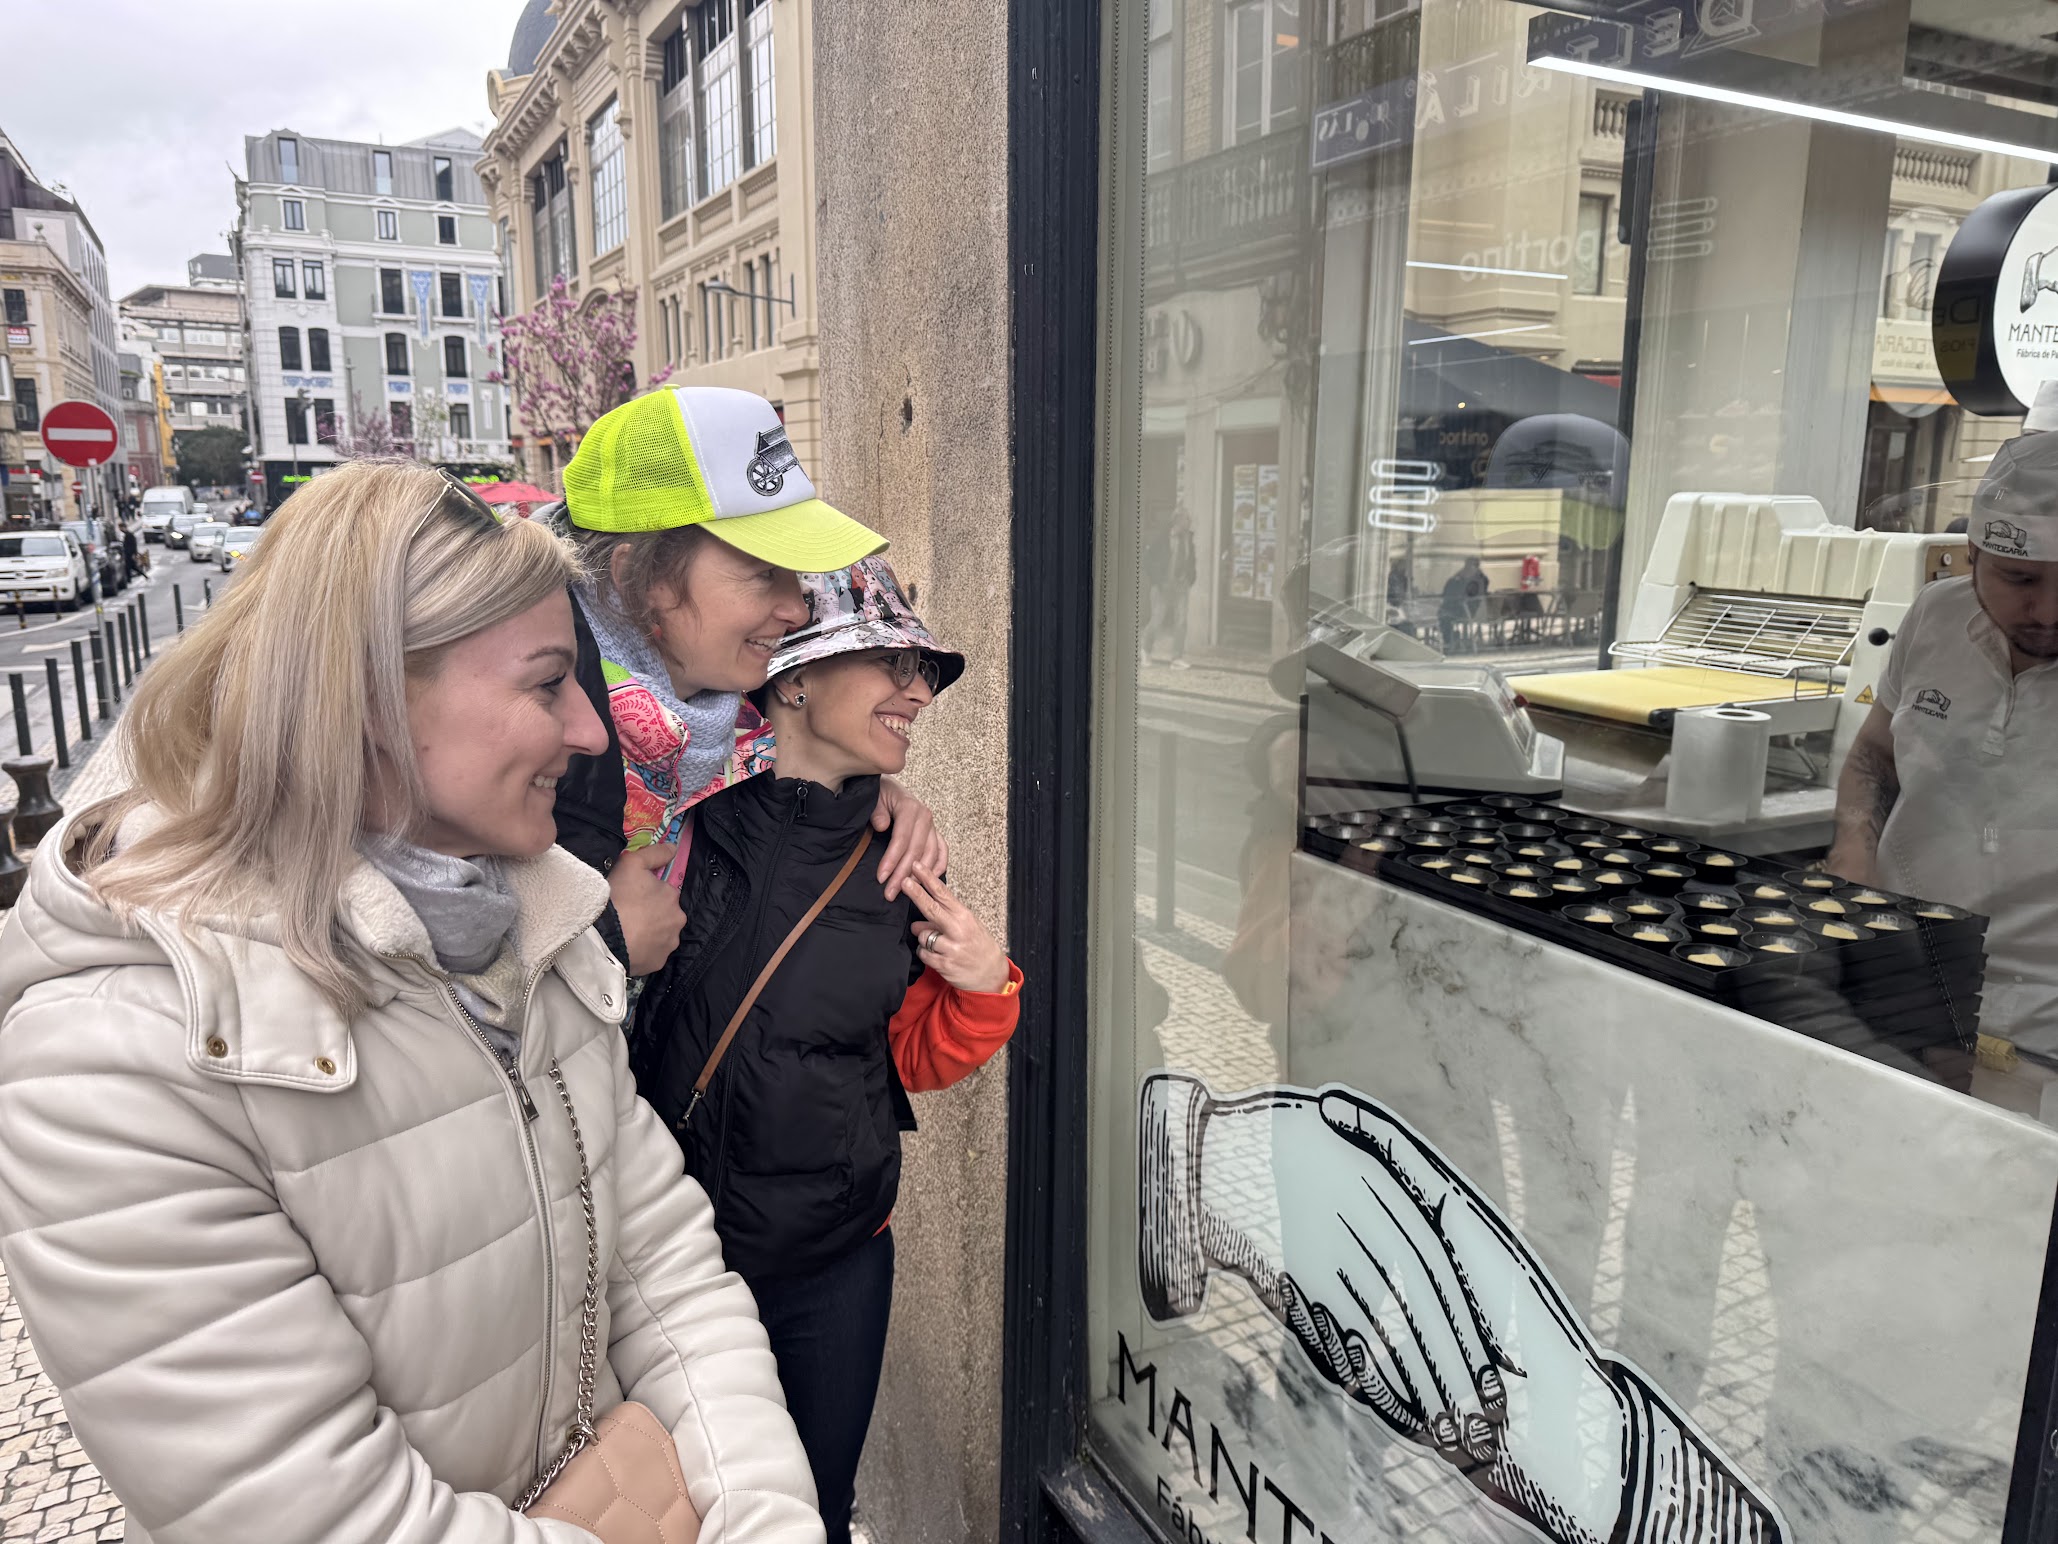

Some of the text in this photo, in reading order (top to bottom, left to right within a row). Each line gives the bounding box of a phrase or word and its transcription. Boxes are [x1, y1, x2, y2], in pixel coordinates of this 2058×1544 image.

[2041, 350, 2050, 359] de
[1982, 540, 2029, 557] MANTEIGARIA
[1117, 1330, 1336, 1544] MANT
